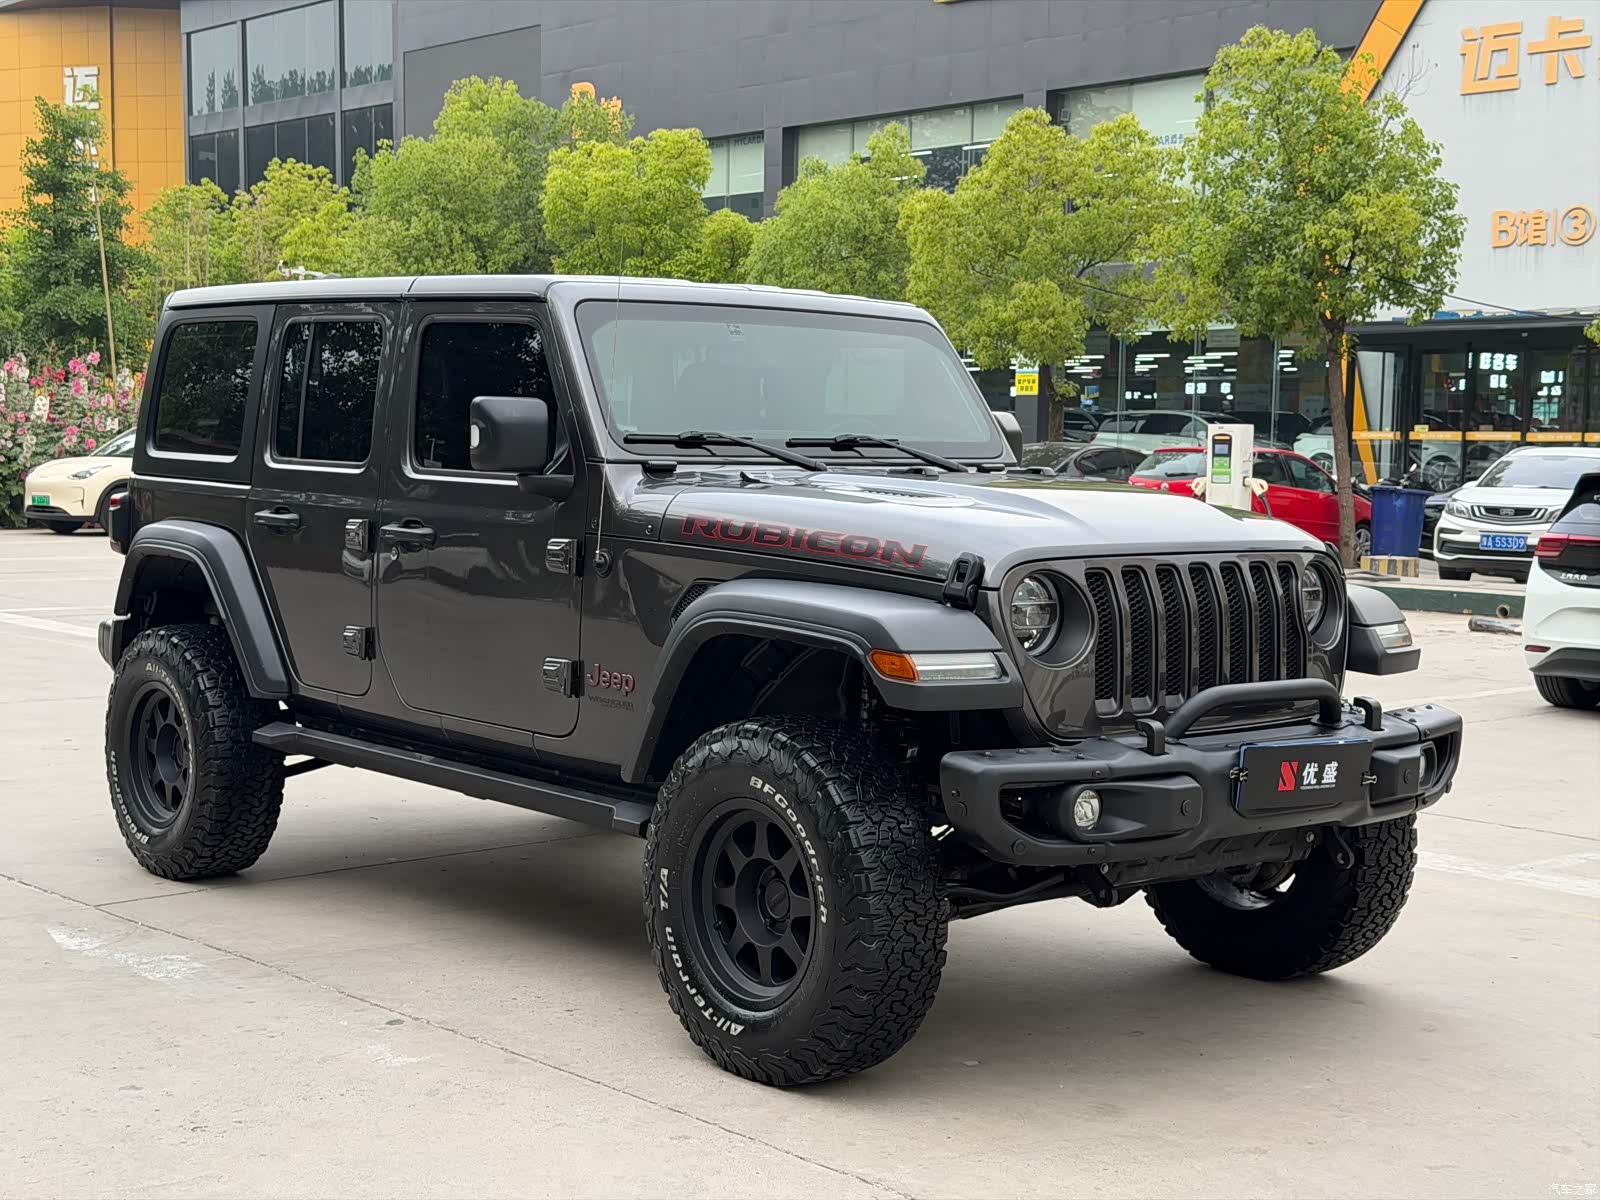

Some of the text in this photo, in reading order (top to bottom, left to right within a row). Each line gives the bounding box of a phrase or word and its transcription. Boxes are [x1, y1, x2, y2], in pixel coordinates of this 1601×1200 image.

[681, 514, 928, 568] RUBICON
[586, 663, 636, 697] Jeep
[750, 775, 828, 924] BFGoodrich
[659, 867, 745, 1036] All-Terrain T/A
